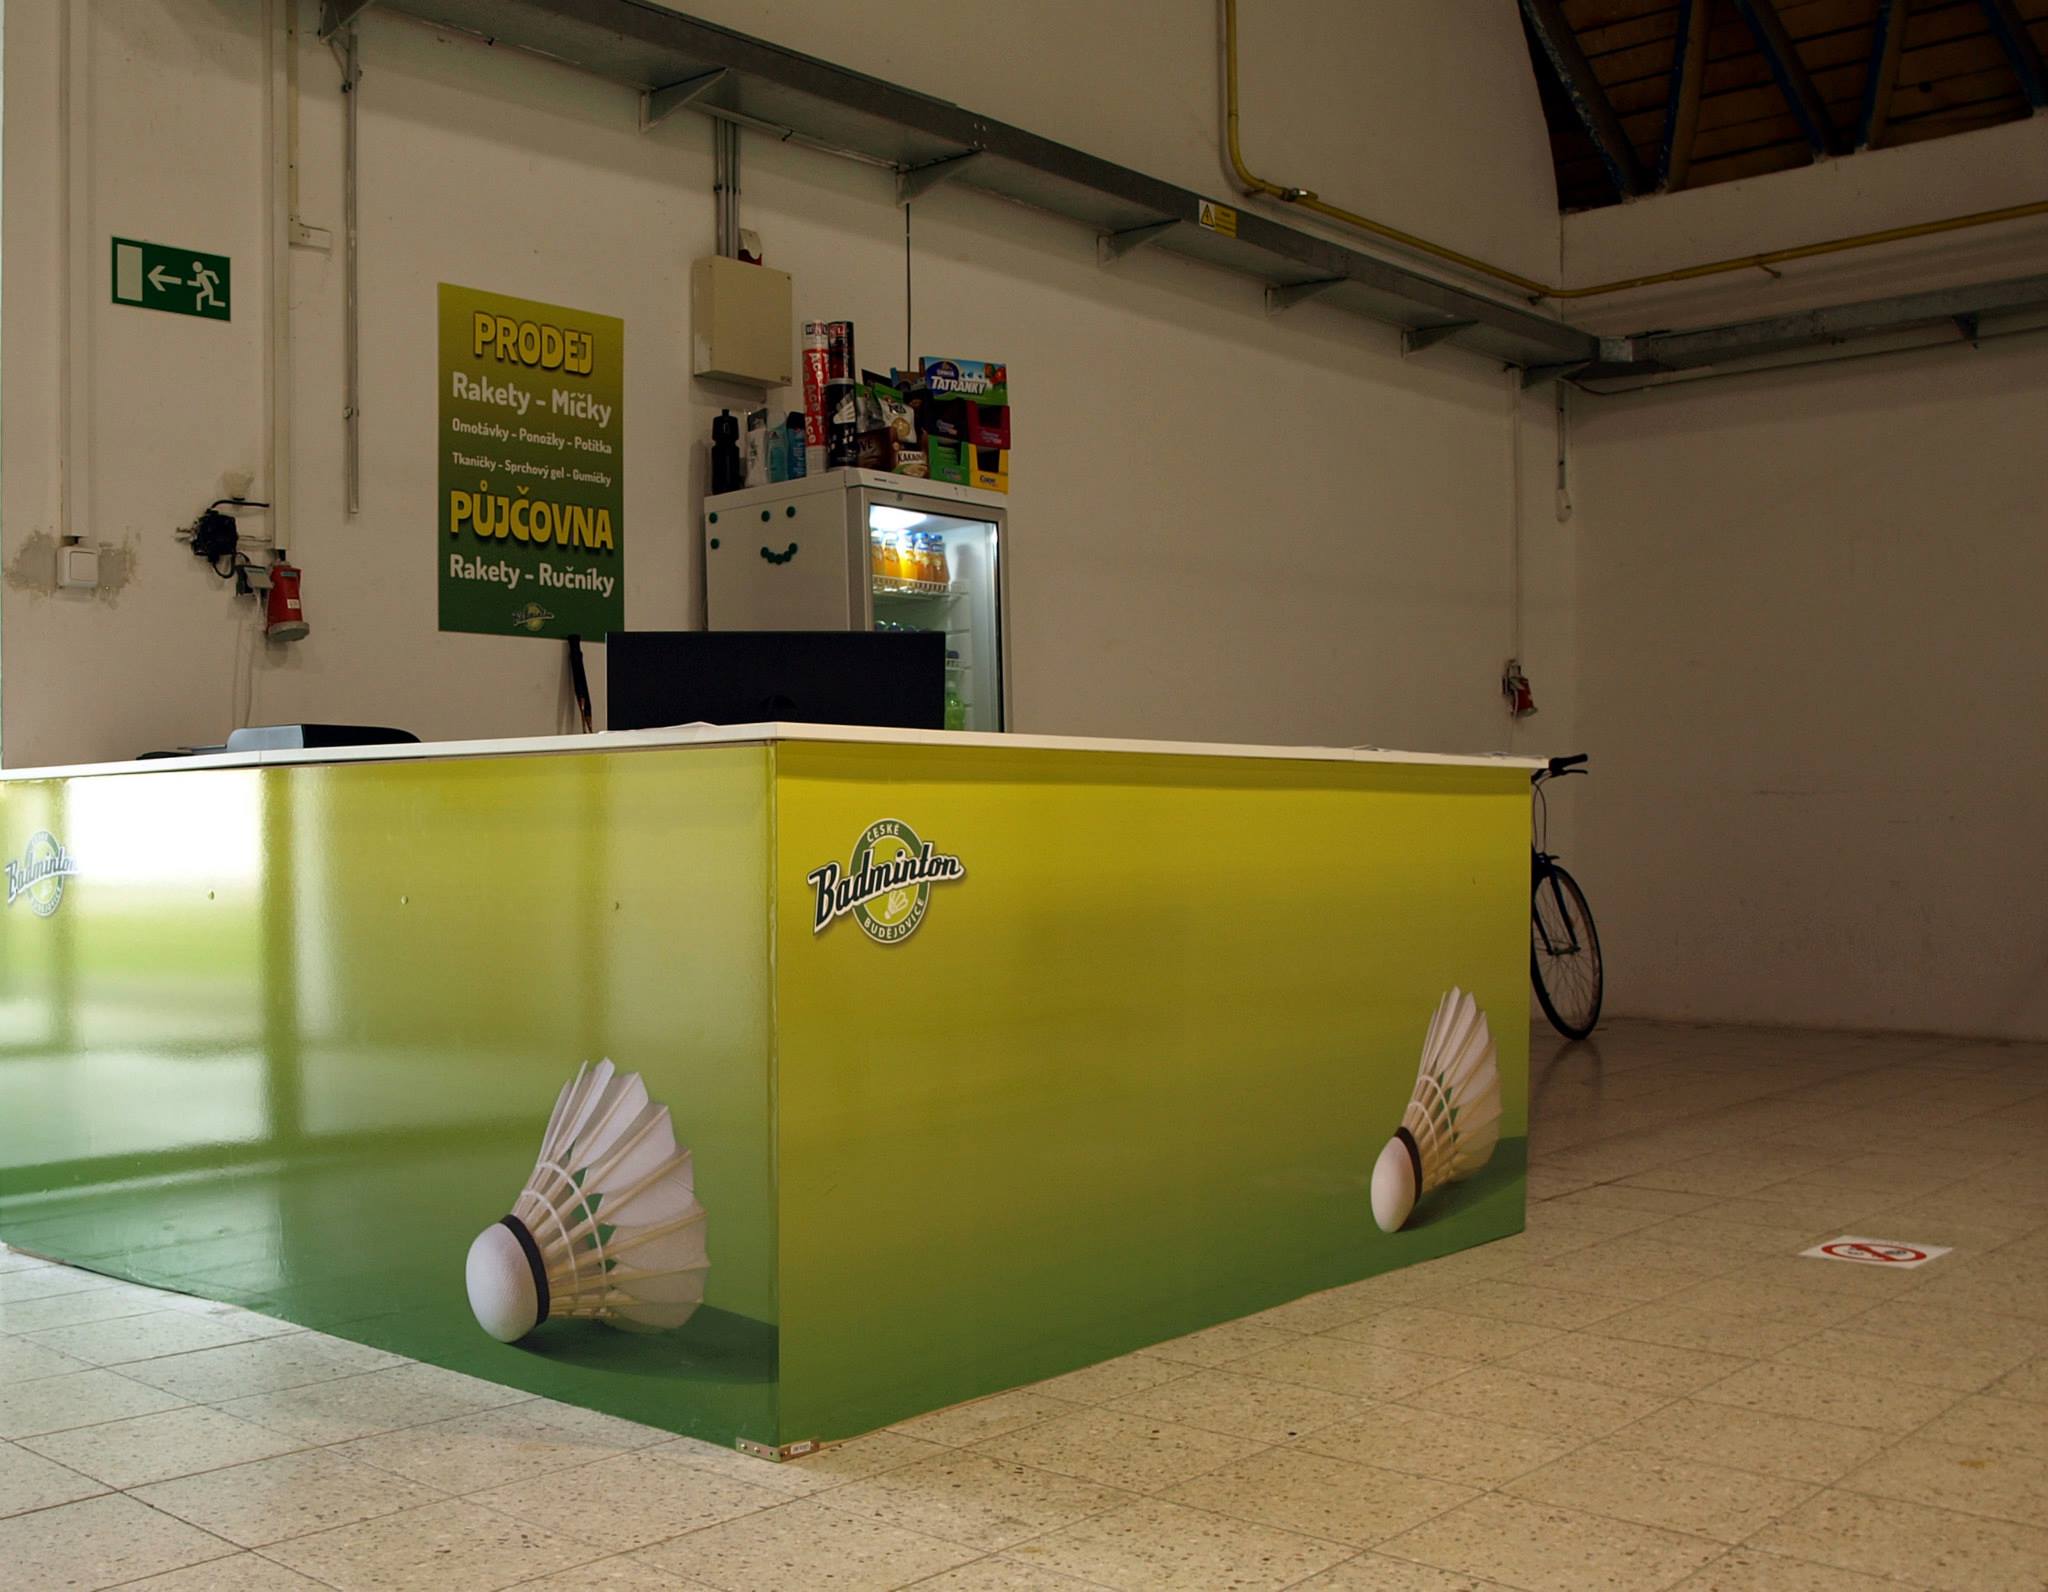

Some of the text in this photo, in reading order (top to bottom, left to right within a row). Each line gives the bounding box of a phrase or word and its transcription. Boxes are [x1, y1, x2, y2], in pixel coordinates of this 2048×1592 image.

[473, 311, 593, 375] PRODEJ
[452, 371, 530, 415] Rakety
[551, 388, 612, 428] Míčky
[930, 376, 986, 395] TATRANKY
[452, 417, 510, 442] Omotávky
[519, 428, 565, 450] Ponožky
[452, 452, 496, 472] Tkaničky
[504, 459, 549, 479] Sprchový
[550, 467, 565, 480] gel
[572, 469, 612, 487] Gumičky
[450, 480, 614, 550] PŮJČOVNA
[450, 553, 520, 590] Rakety
[539, 563, 615, 598] Ručníky
[808, 842, 964, 932] Badminton
